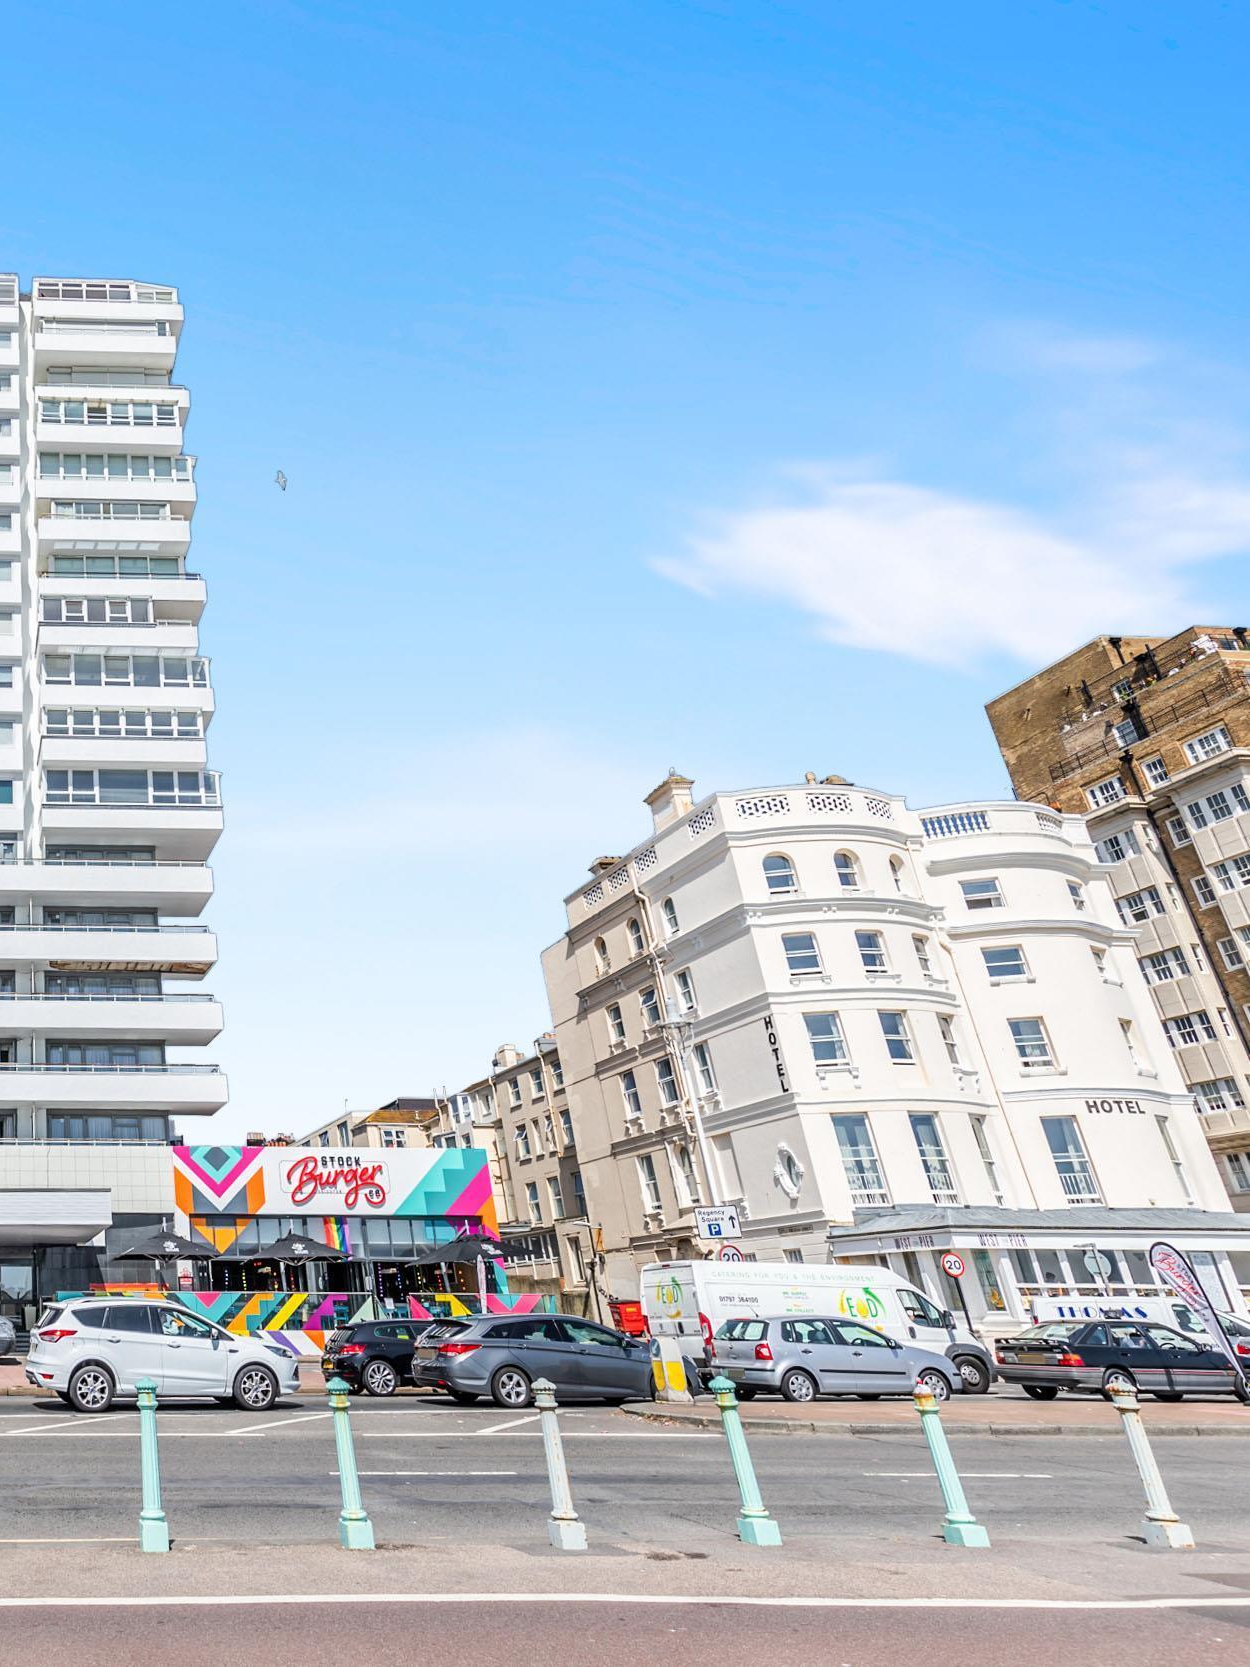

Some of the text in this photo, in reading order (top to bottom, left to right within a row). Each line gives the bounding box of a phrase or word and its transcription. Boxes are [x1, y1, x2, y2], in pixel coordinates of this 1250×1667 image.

[763, 1015, 790, 1093] HOTEL
[1085, 1100, 1146, 1114] HOTEL
[321, 1155, 361, 1167] STOCK
[287, 1156, 386, 1207] Burger
[697, 1209, 725, 1217] Regency
[894, 1235, 934, 1249] WEST PIER
[977, 1232, 1030, 1247] WEST PIER
[945, 1260, 961, 1270] 20
[711, 1271, 750, 1279] CATERING
[821, 1274, 875, 1282] ENVIRONMENT
